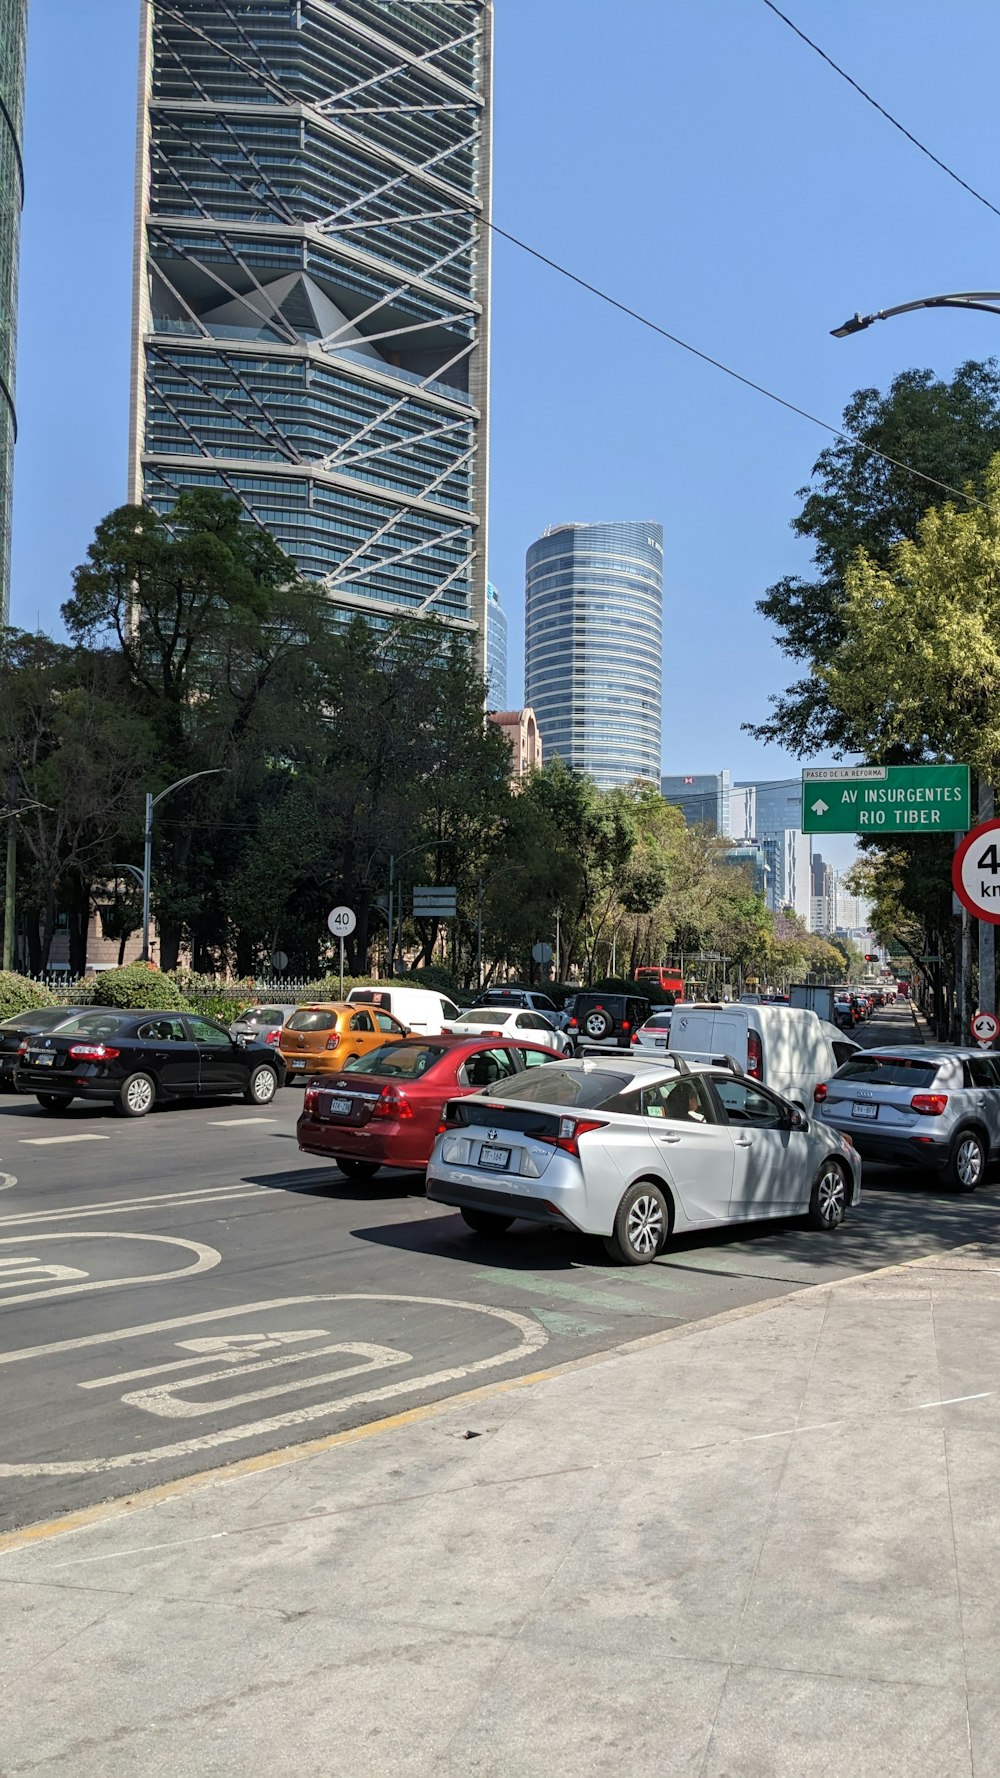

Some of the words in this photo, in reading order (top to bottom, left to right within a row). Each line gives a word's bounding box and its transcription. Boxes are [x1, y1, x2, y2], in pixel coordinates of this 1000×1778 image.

[841, 789, 858, 804] AV
[864, 787, 962, 803] INSURGENTES
[859, 810, 886, 825] RIO
[893, 809, 941, 824] TIBER
[334, 912, 350, 925] 40
